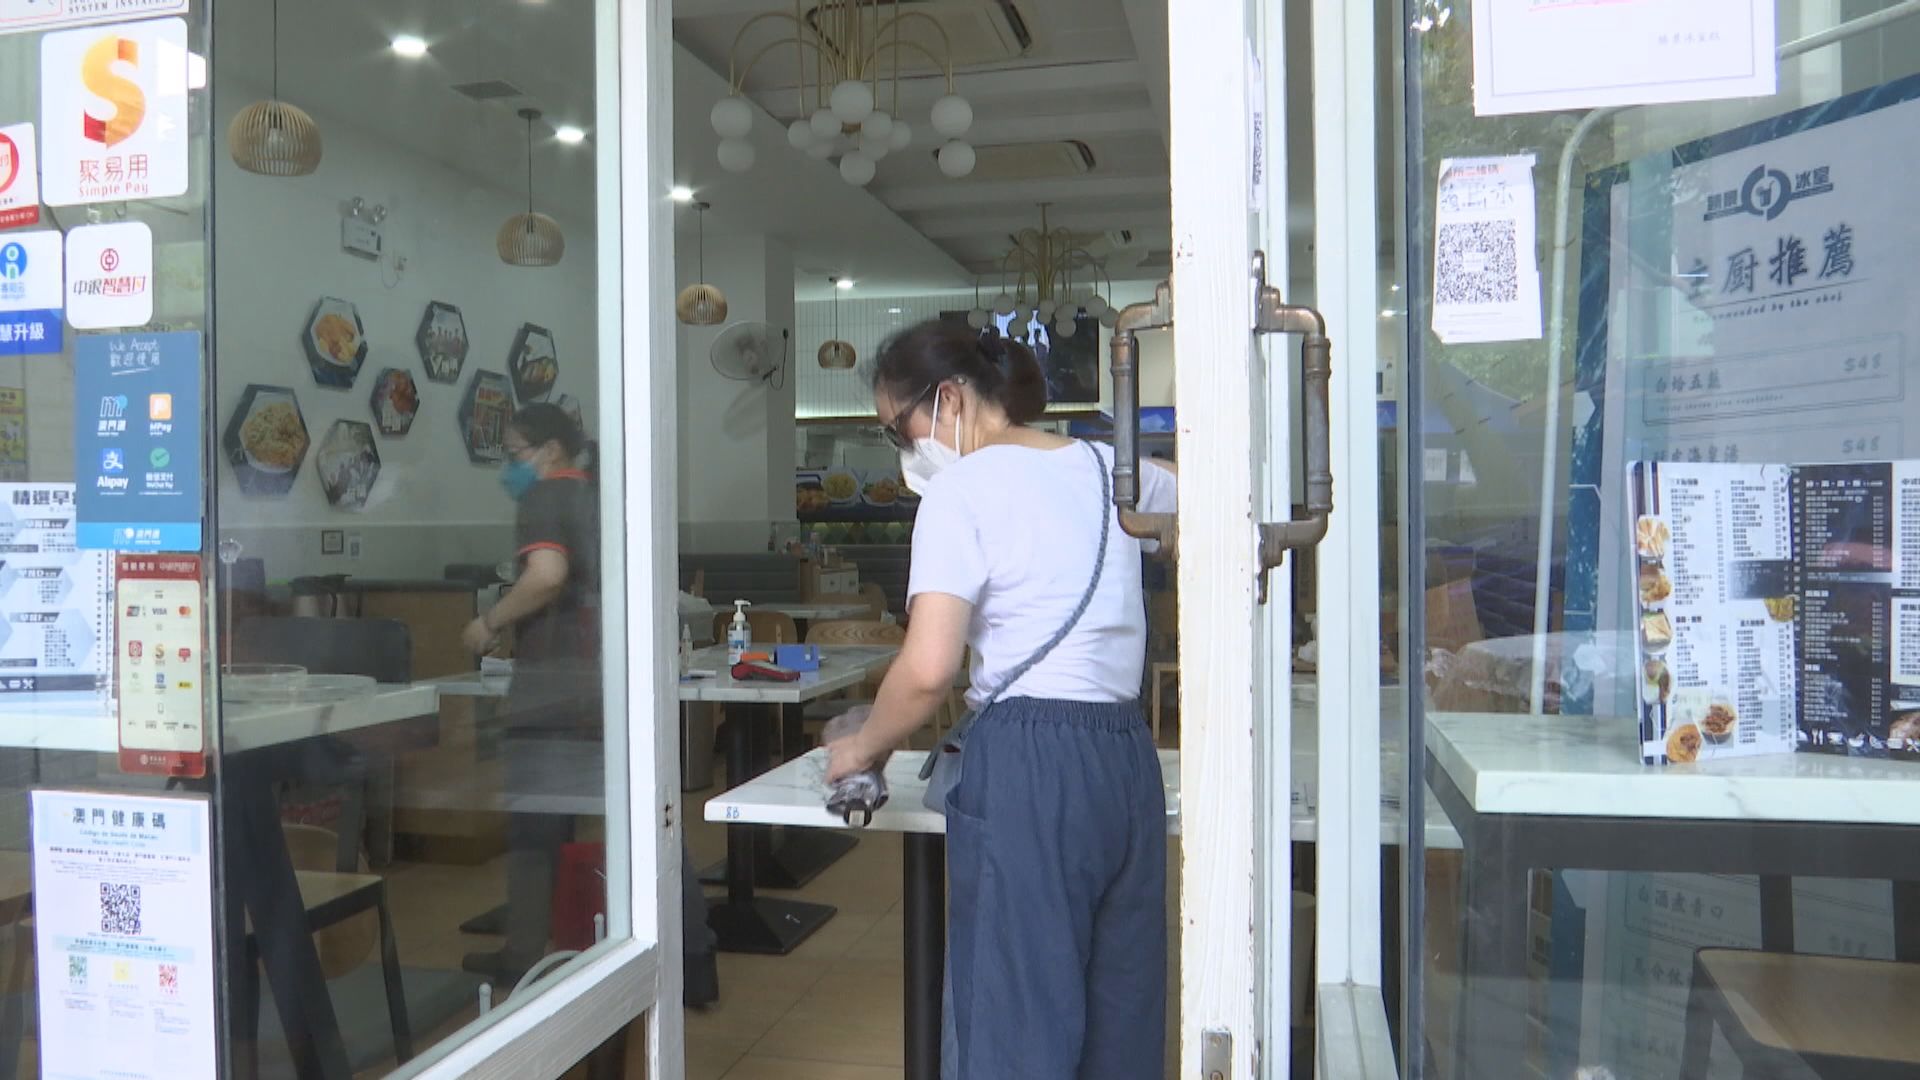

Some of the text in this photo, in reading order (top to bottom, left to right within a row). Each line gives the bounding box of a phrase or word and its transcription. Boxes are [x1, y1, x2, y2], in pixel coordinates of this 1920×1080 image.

[68, 2, 108, 14] SYSTEM
[79, 153, 149, 184] 聚易用
[79, 181, 149, 197] Simple Pay
[109, 337, 159, 352] We Accept
[110, 351, 160, 368] 歡迎使用
[13, 490, 76, 505] 精選早
[72, 807, 167, 830] 澳門健康碼
